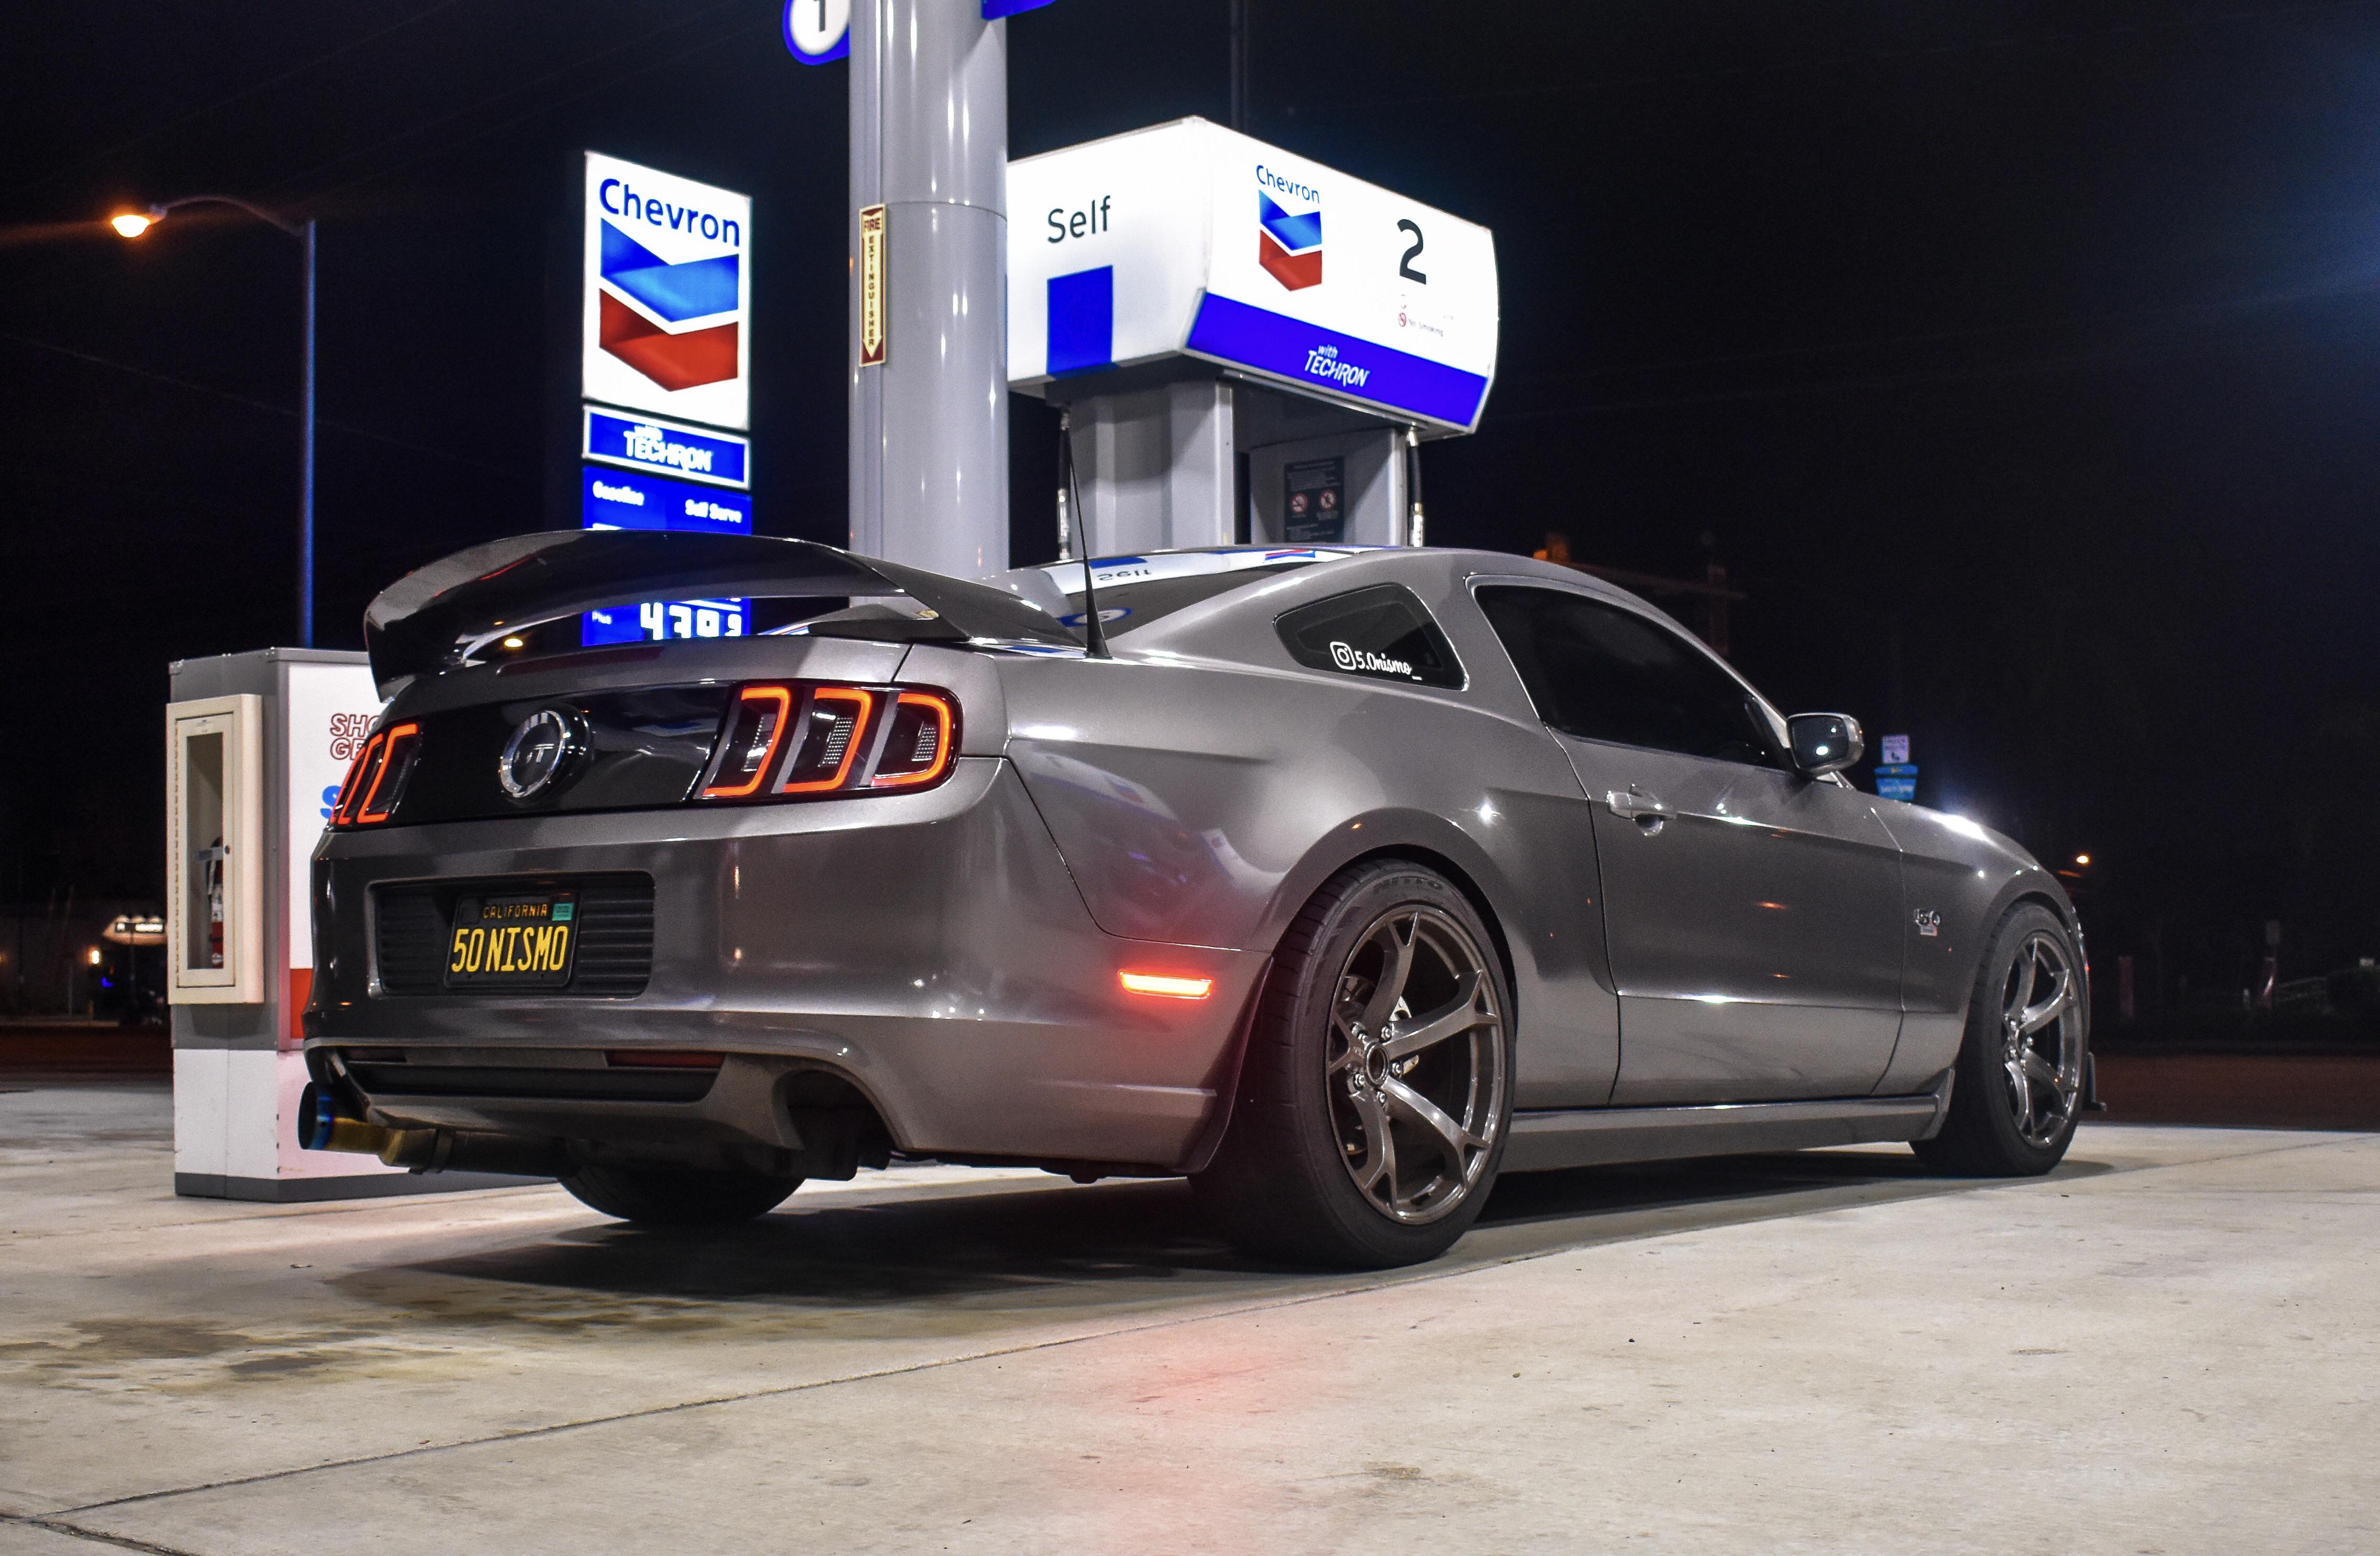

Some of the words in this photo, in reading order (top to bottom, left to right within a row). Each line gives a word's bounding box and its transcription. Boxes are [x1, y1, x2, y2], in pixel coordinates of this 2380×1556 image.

[1256, 165, 1320, 204] Chevron
[599, 178, 739, 247] Chevron
[1047, 195, 1110, 243] Self
[1396, 219, 1426, 285] 2
[1304, 350, 1371, 388] TECHRON
[623, 430, 712, 472] TECHRON
[483, 904, 548, 918] CALIFORNIA
